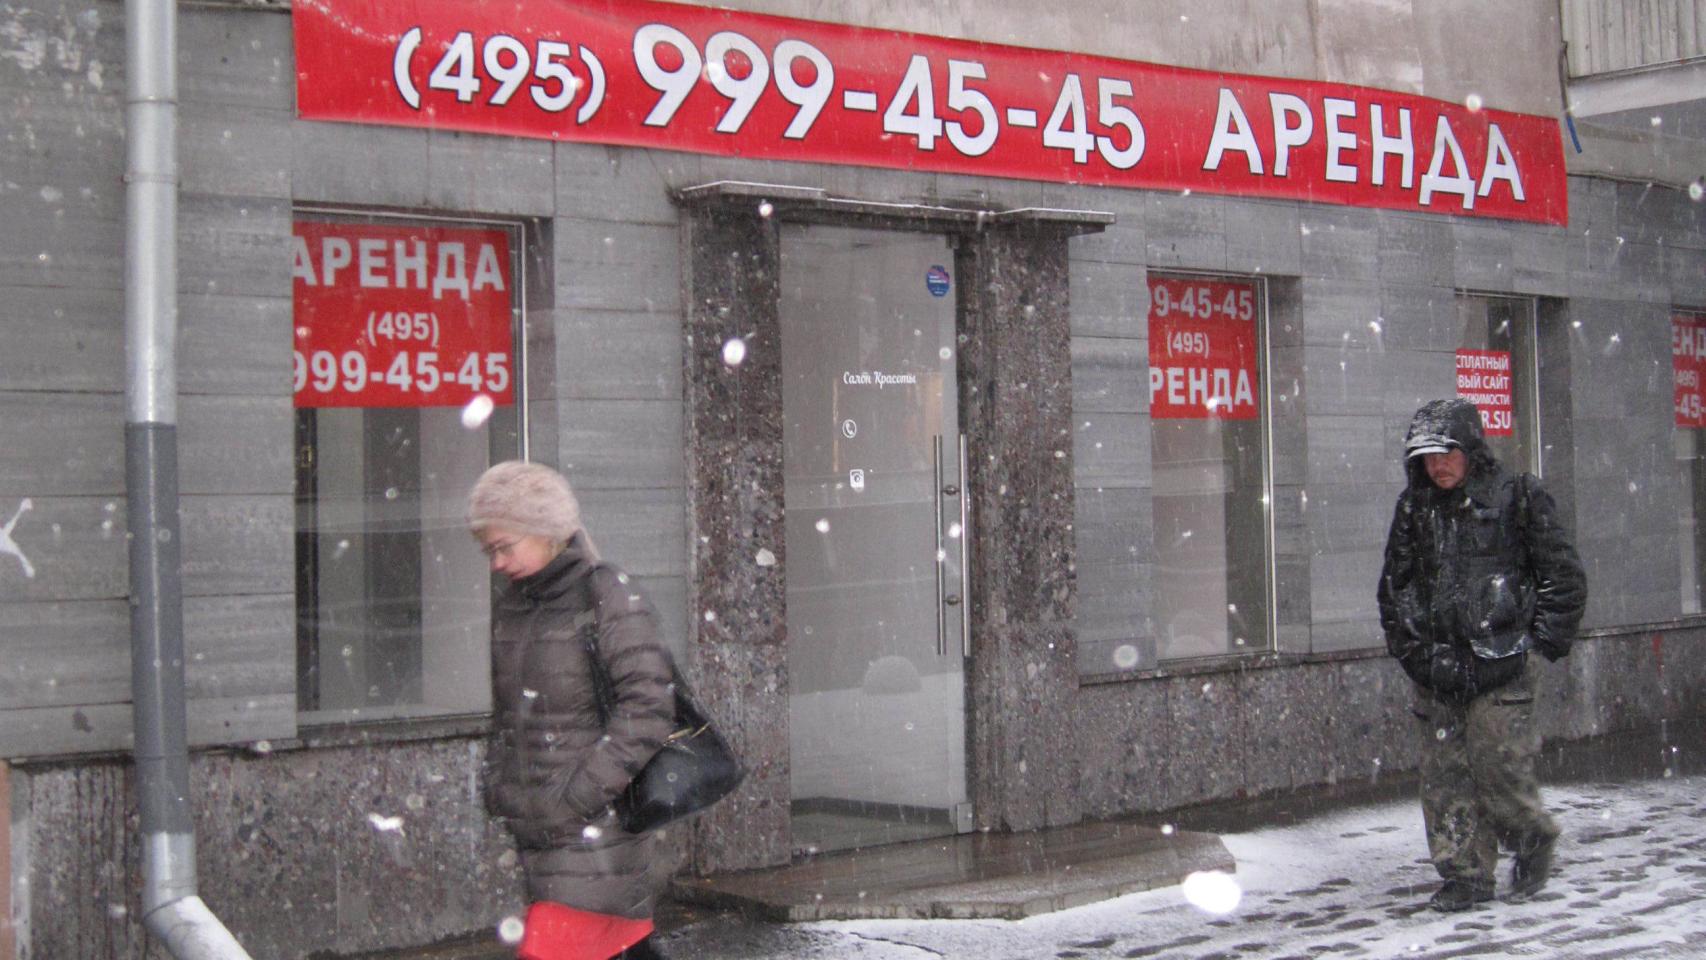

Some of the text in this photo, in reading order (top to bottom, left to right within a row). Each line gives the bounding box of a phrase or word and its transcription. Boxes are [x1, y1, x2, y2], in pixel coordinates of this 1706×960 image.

[393, 22, 1526, 210] (495) 999-45-45 АРЕНДА
[292, 235, 505, 300] АРЕНДА
[1147, 283, 1254, 321] 9-45-45
[367, 310, 440, 348] (495)
[1166, 331, 1210, 360] (495)
[843, 371, 917, 390] Салон Красоты
[1149, 366, 1255, 413] РЕНДА
[1456, 373, 1510, 390] ВЫЙ САЙТ
[1478, 410, 1512, 430] R.SU
